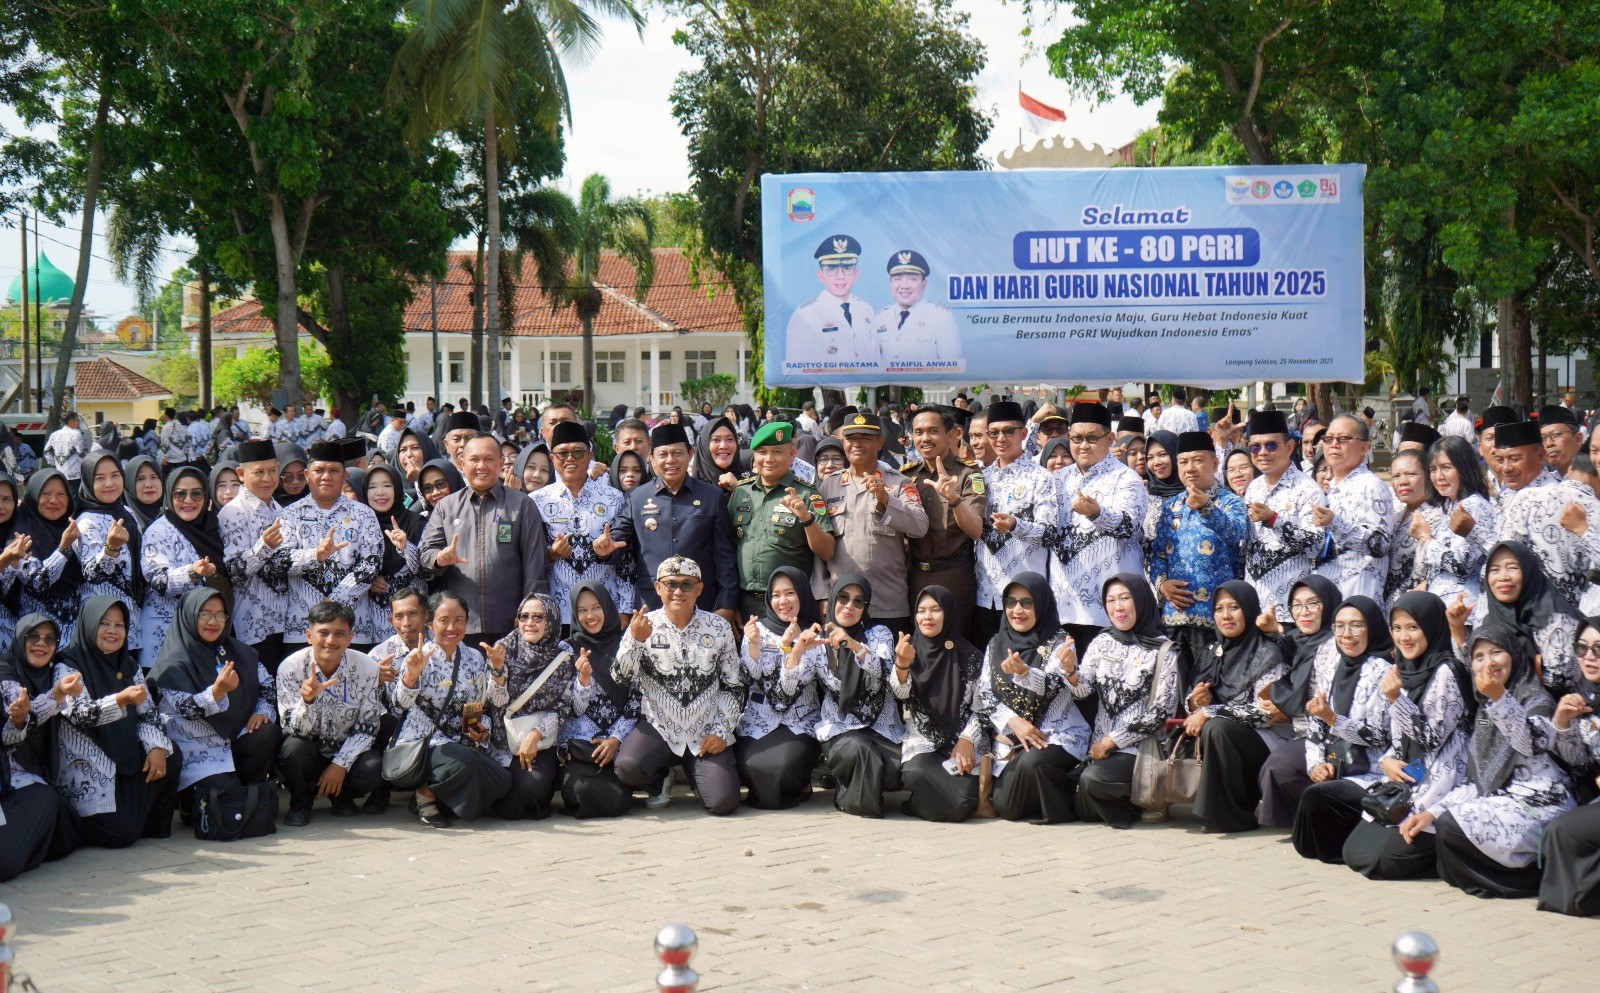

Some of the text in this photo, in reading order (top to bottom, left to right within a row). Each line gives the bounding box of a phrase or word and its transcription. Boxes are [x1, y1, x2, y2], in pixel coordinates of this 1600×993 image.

[1083, 207, 1189, 225] Selamat
[1029, 236, 1081, 263] HUT
[1087, 236, 1118, 263] KE
[1140, 235, 1175, 262] 80
[1182, 234, 1244, 261] PGRI
[949, 271, 1326, 300] DAN HARI GURU NASIONAL TAHUN 2025
[1002, 314, 1052, 323] Bermutu
[1055, 313, 1113, 323] Indonesia
[1115, 312, 1147, 325] Maju,
[1151, 312, 1179, 322] Guru
[1182, 311, 1217, 321] Hebat
[1220, 311, 1278, 321] Indonesia
[1281, 310, 1308, 320] Kuat
[1016, 329, 1066, 339] Bersama
[1070, 329, 1097, 338] PGRI
[1101, 328, 1158, 340] Wujudkan
[1161, 327, 1218, 337] Indonesia
